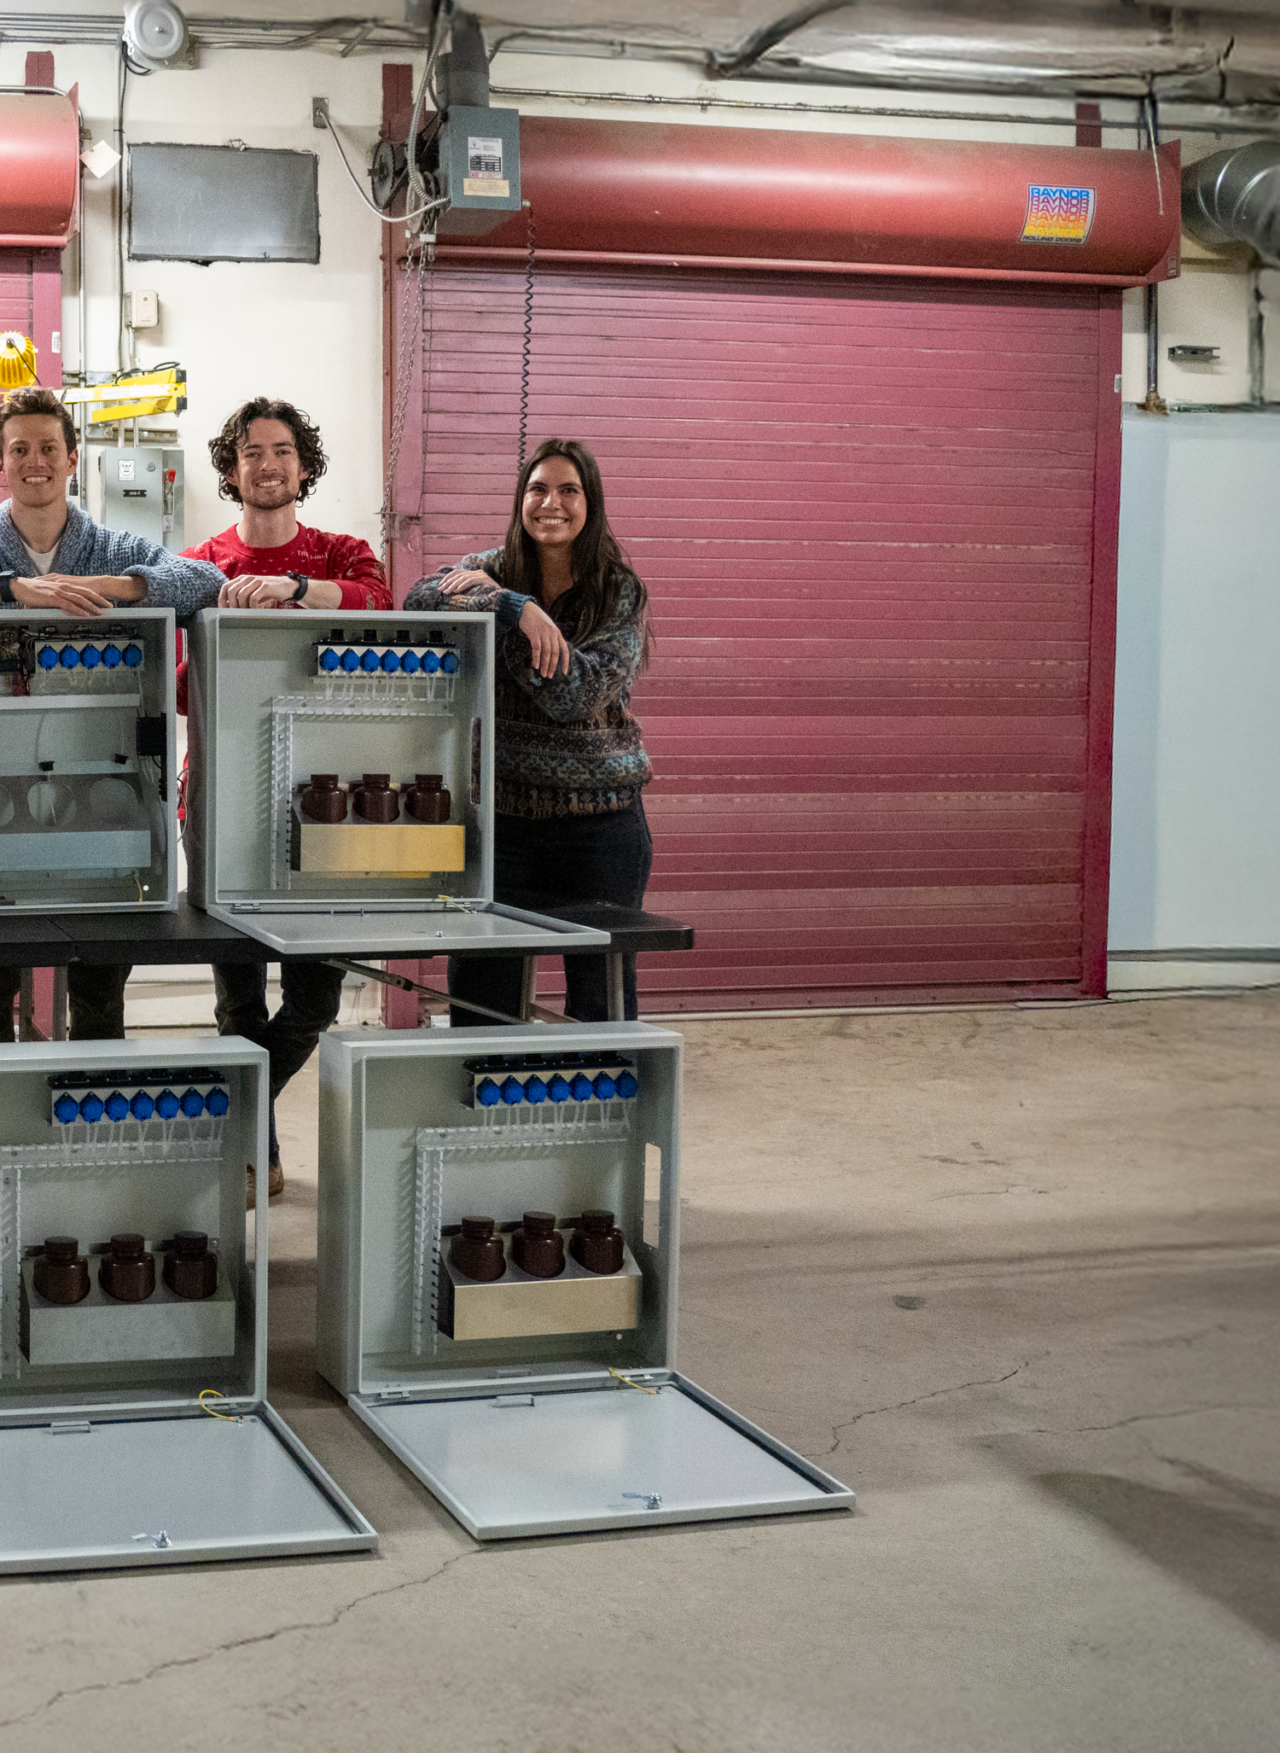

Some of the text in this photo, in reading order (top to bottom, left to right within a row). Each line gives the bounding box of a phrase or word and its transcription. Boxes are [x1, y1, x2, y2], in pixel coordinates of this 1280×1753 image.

[1031, 188, 1089, 199] RAYNOR
[1031, 195, 1089, 207] RAYNOR
[1030, 203, 1089, 215] RAYNOR
[1029, 211, 1088, 223] RAYNOR
[1025, 226, 1085, 238] RAYNOR
